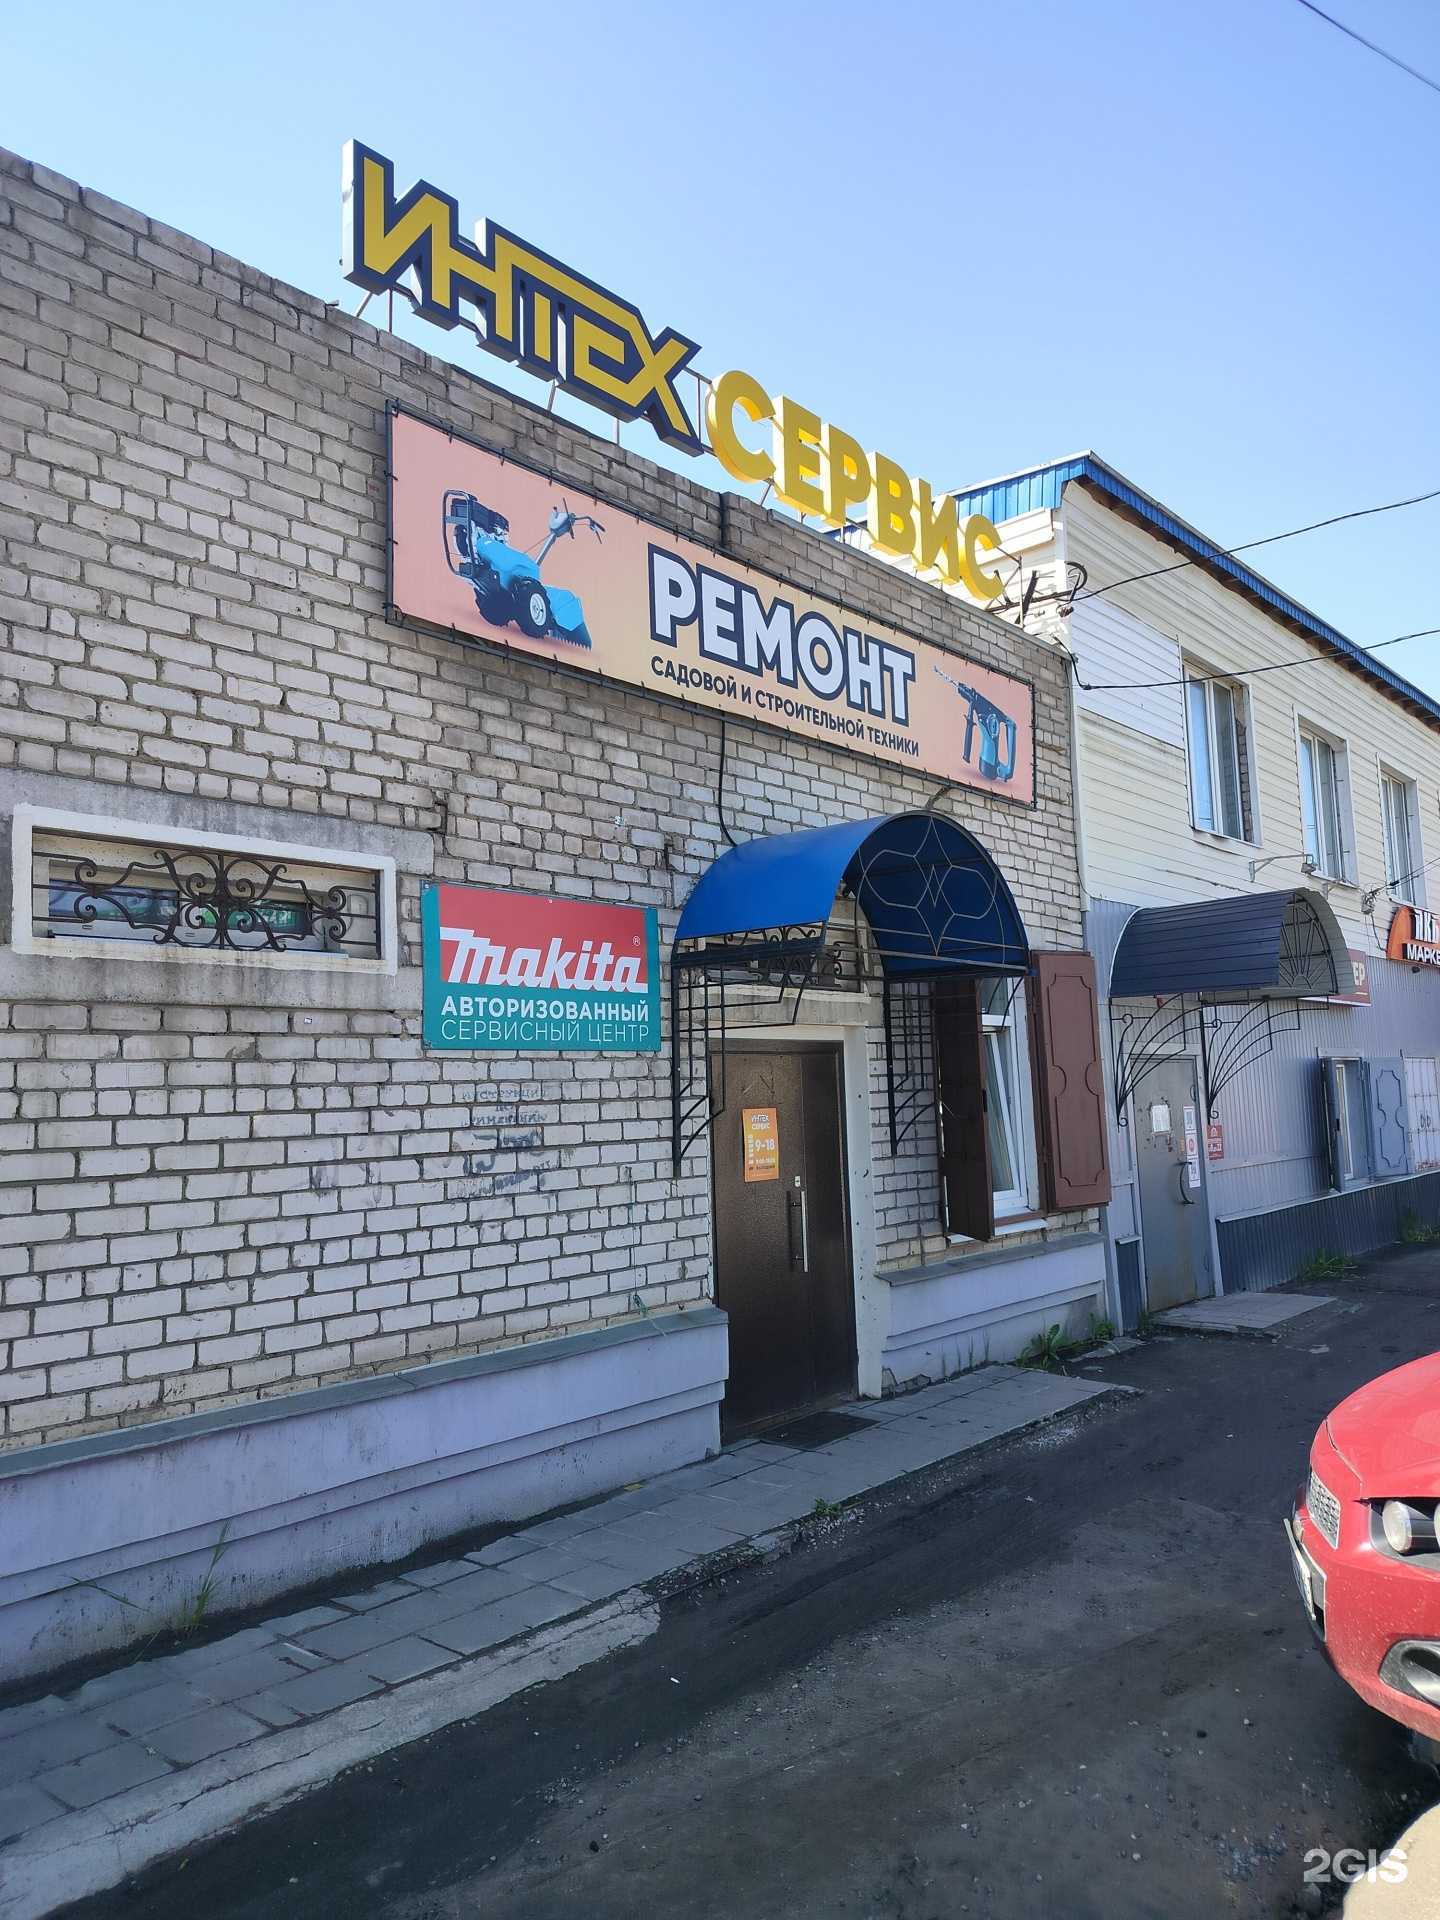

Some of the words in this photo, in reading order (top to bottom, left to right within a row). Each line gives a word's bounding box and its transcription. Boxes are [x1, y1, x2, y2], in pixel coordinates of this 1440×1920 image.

[342, 139, 703, 456] ИНТЕХ
[706, 370, 1002, 600] СЕРВИС
[648, 543, 916, 726] РЕМОНТ
[651, 655, 737, 699] САДОВОЙ
[740, 684, 752, 704] И
[755, 691, 864, 741] СТРОИТЕЛЬНОЙ
[867, 726, 920, 757] ТЕХНИКИ
[441, 996, 649, 1022] АВТОРИЗОВАННЫЙ
[441, 1020, 580, 1041] СЕРВИСНЫЙ
[588, 1023, 649, 1043] ЦЕНТР
